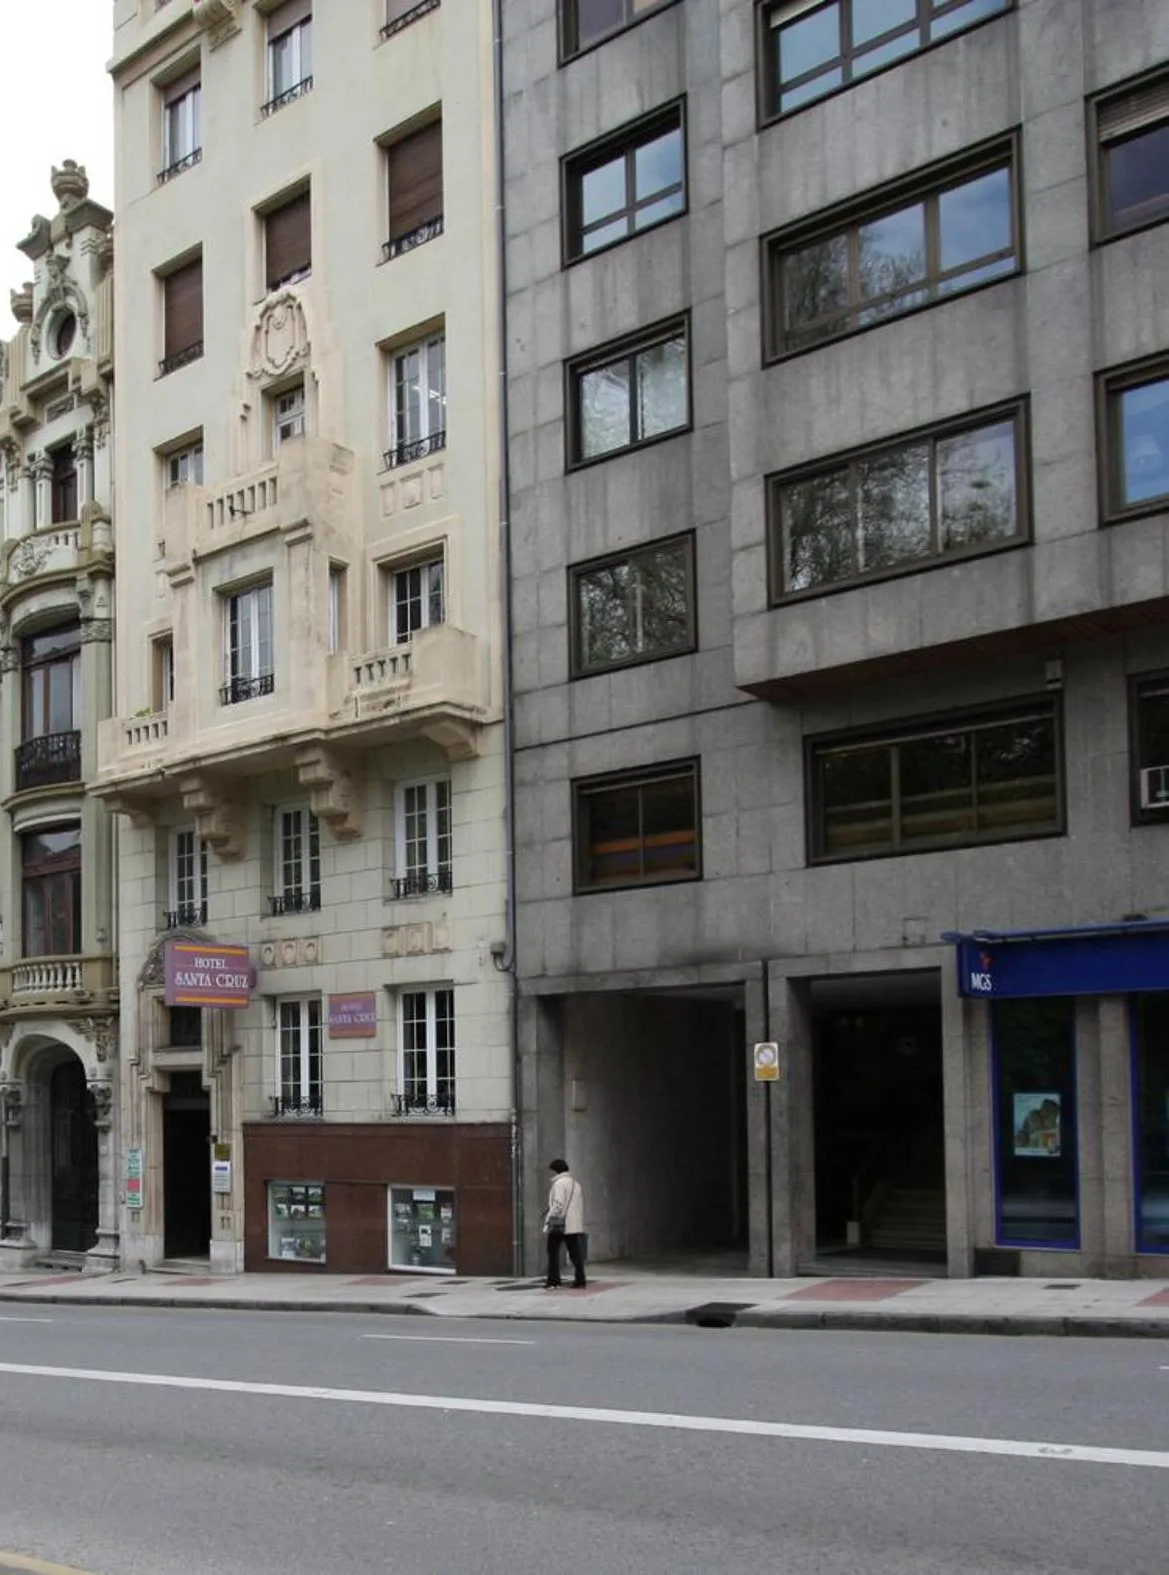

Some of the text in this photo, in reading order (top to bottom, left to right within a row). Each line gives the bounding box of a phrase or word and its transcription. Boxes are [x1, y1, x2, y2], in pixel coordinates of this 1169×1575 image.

[194, 957, 228, 969] HOTEL
[174, 971, 248, 989] SANTA CRUZ
[971, 972, 992, 991] MGS
